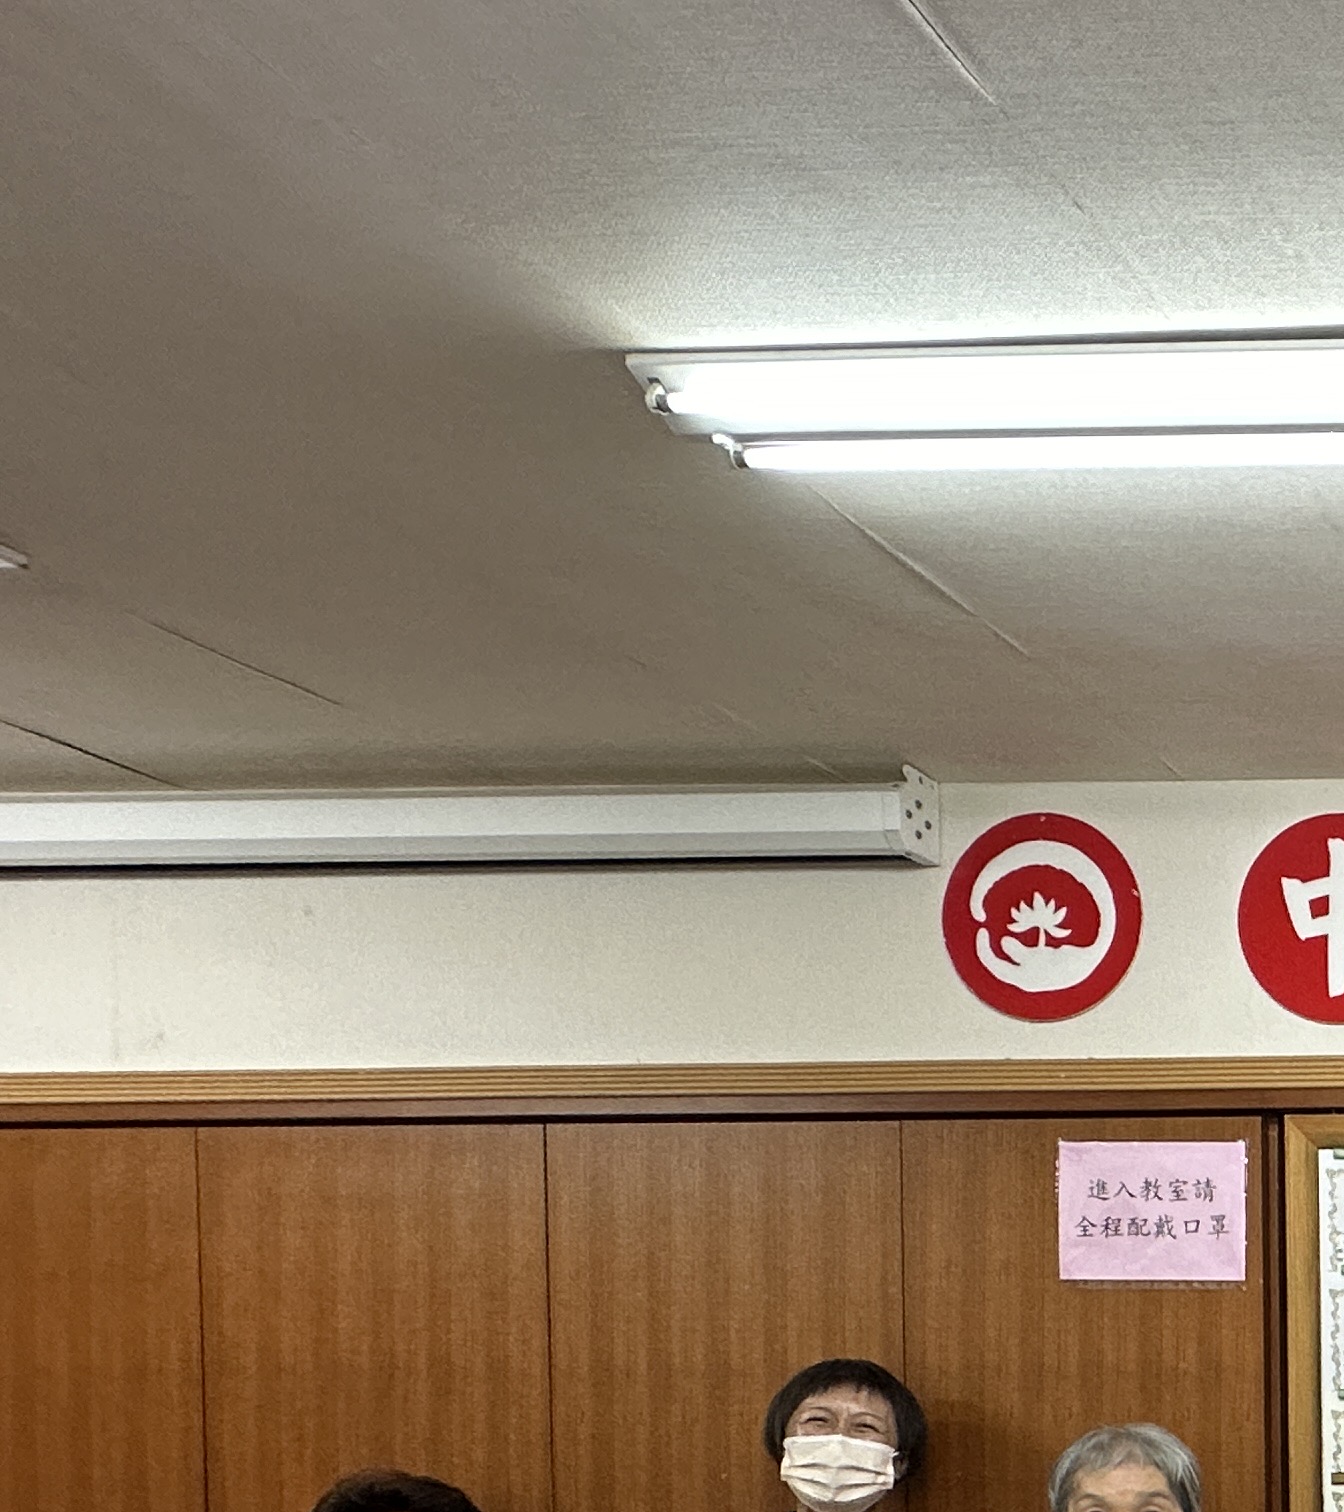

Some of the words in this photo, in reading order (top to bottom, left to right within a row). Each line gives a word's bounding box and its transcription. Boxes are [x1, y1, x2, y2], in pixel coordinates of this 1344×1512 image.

[1087, 1177, 1217, 1203] 進入教室請
[1075, 1214, 1229, 1241] 全程配戴口罩
